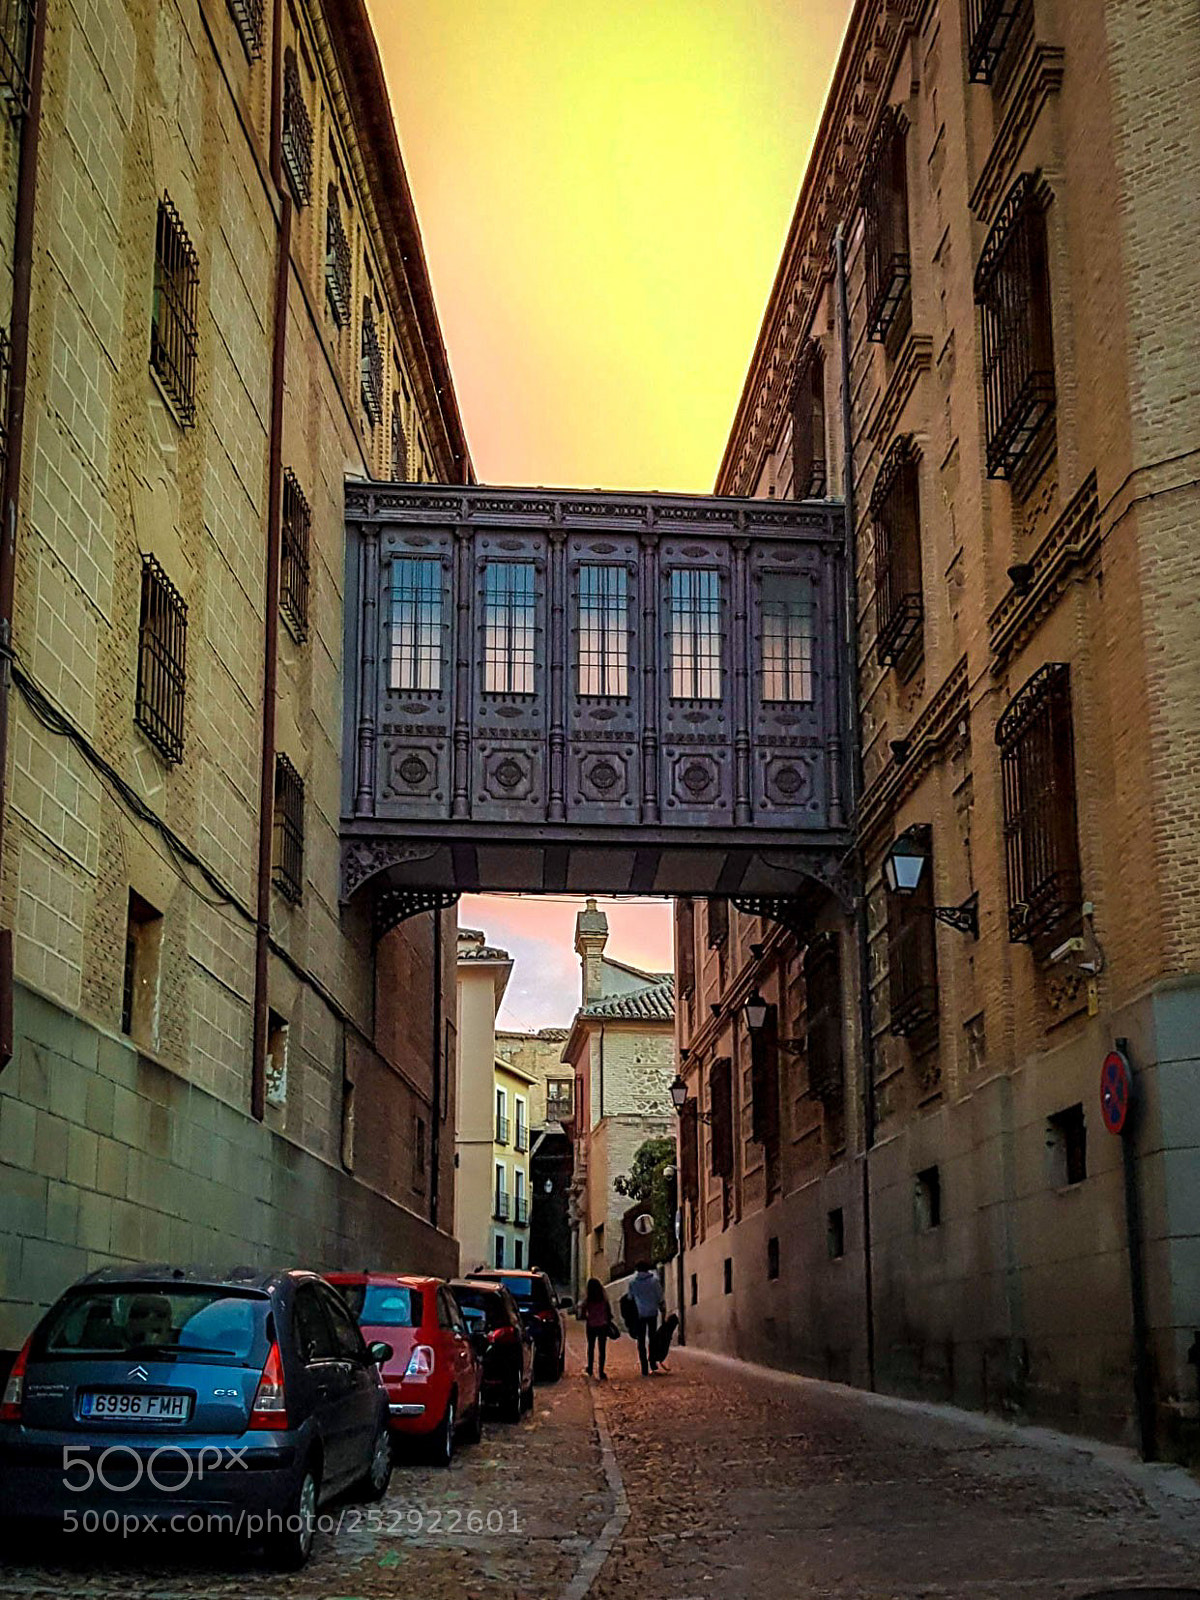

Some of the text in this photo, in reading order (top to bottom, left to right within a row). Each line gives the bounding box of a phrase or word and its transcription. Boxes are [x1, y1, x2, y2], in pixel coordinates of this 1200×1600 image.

[213, 1388, 239, 1396] C3
[95, 1395, 183, 1415] 6996 FMH
